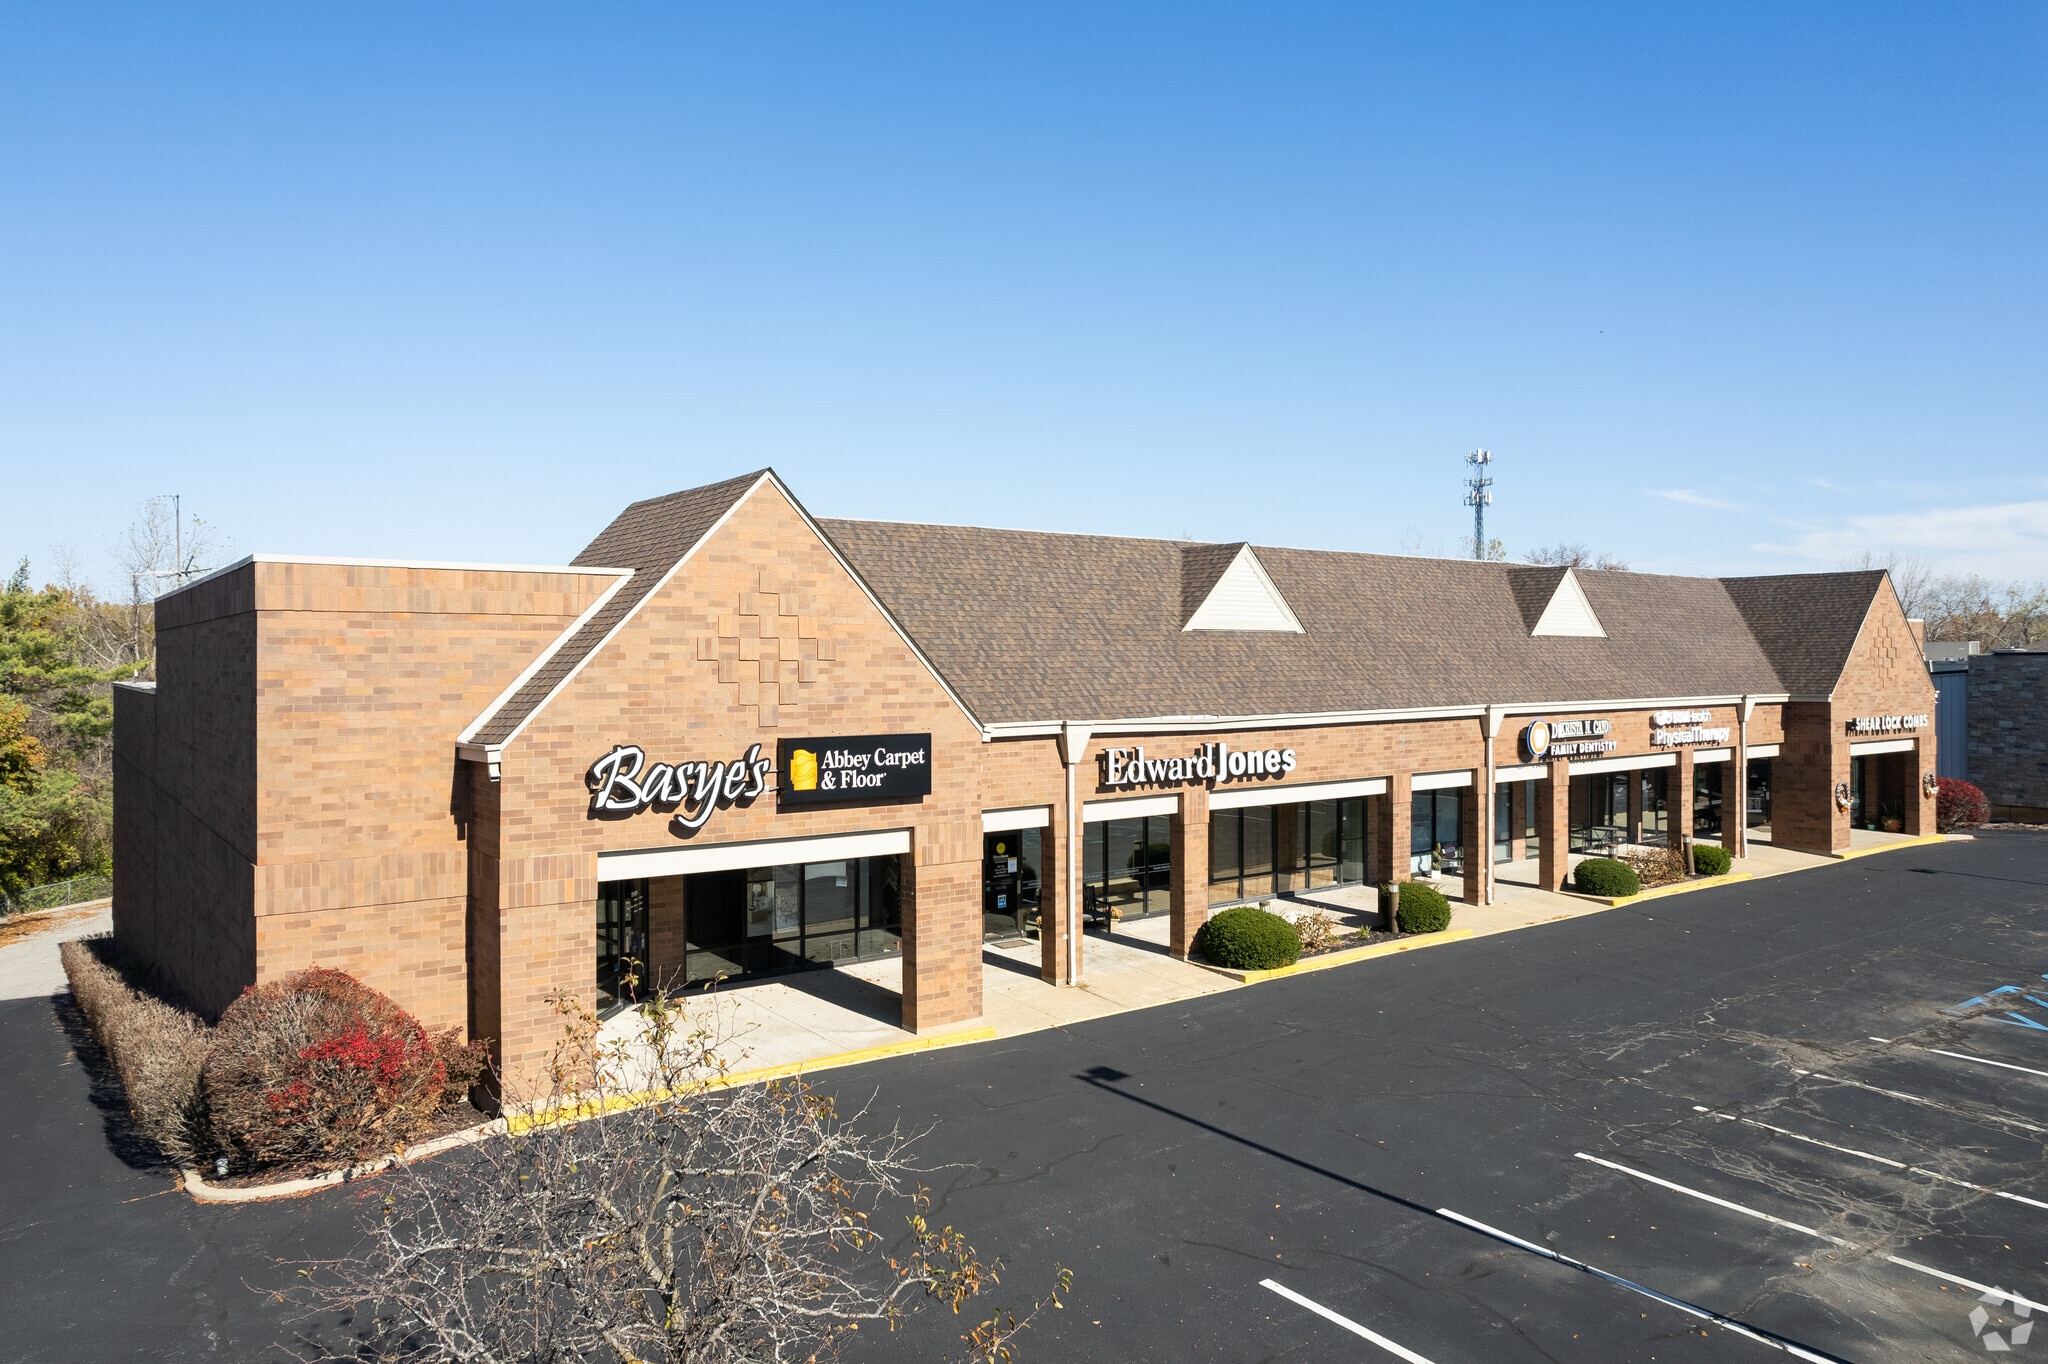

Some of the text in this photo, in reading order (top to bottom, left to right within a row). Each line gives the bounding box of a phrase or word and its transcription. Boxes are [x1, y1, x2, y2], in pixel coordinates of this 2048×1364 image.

[1856, 714, 1928, 730] SHEAR LOCK COMBS
[1551, 741, 1617, 755] FAMILY DENTISTRY
[820, 747, 925, 771] Abbey Carpet
[592, 744, 770, 829] Basye's
[820, 770, 884, 790] & Floor
